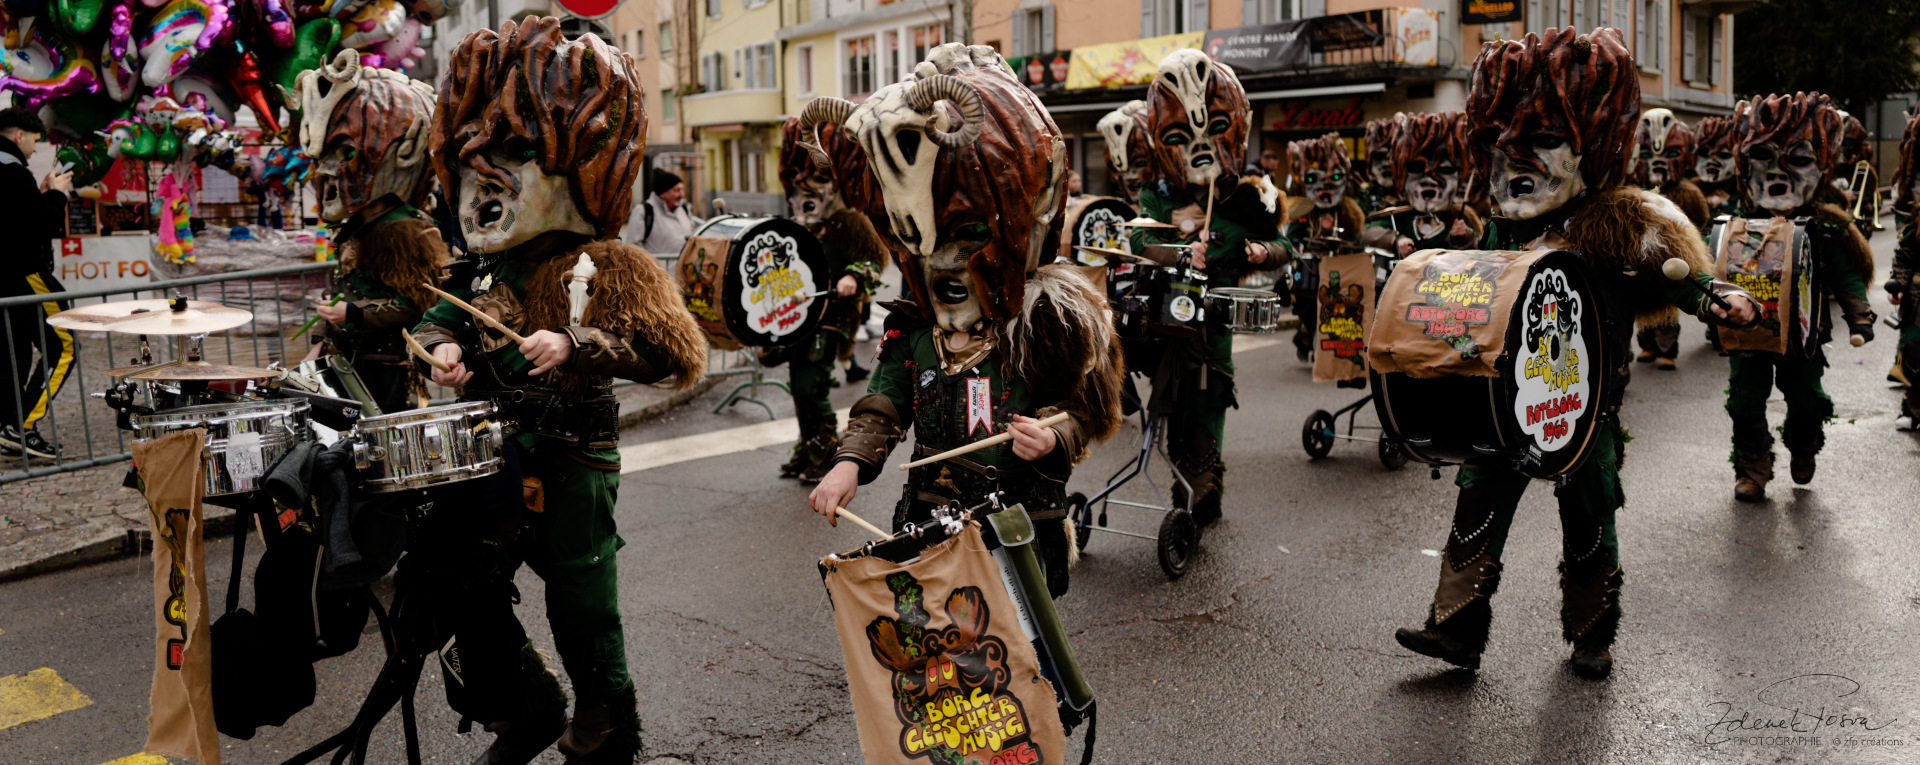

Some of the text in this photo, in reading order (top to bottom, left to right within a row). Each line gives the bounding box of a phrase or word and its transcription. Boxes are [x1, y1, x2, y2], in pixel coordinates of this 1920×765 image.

[1227, 34, 1262, 46] CENTRE
[1222, 46, 1270, 59] MONTHEY
[62, 261, 111, 280] HOT
[1439, 272, 1482, 284] BORG
[1736, 273, 1770, 283] BORG
[1409, 306, 1489, 321] ROTEBORG
[1427, 321, 1466, 337] 1965
[1526, 392, 1582, 426] ROTEBORG
[1542, 418, 1569, 444] 1965
[925, 686, 991, 723] BORG
